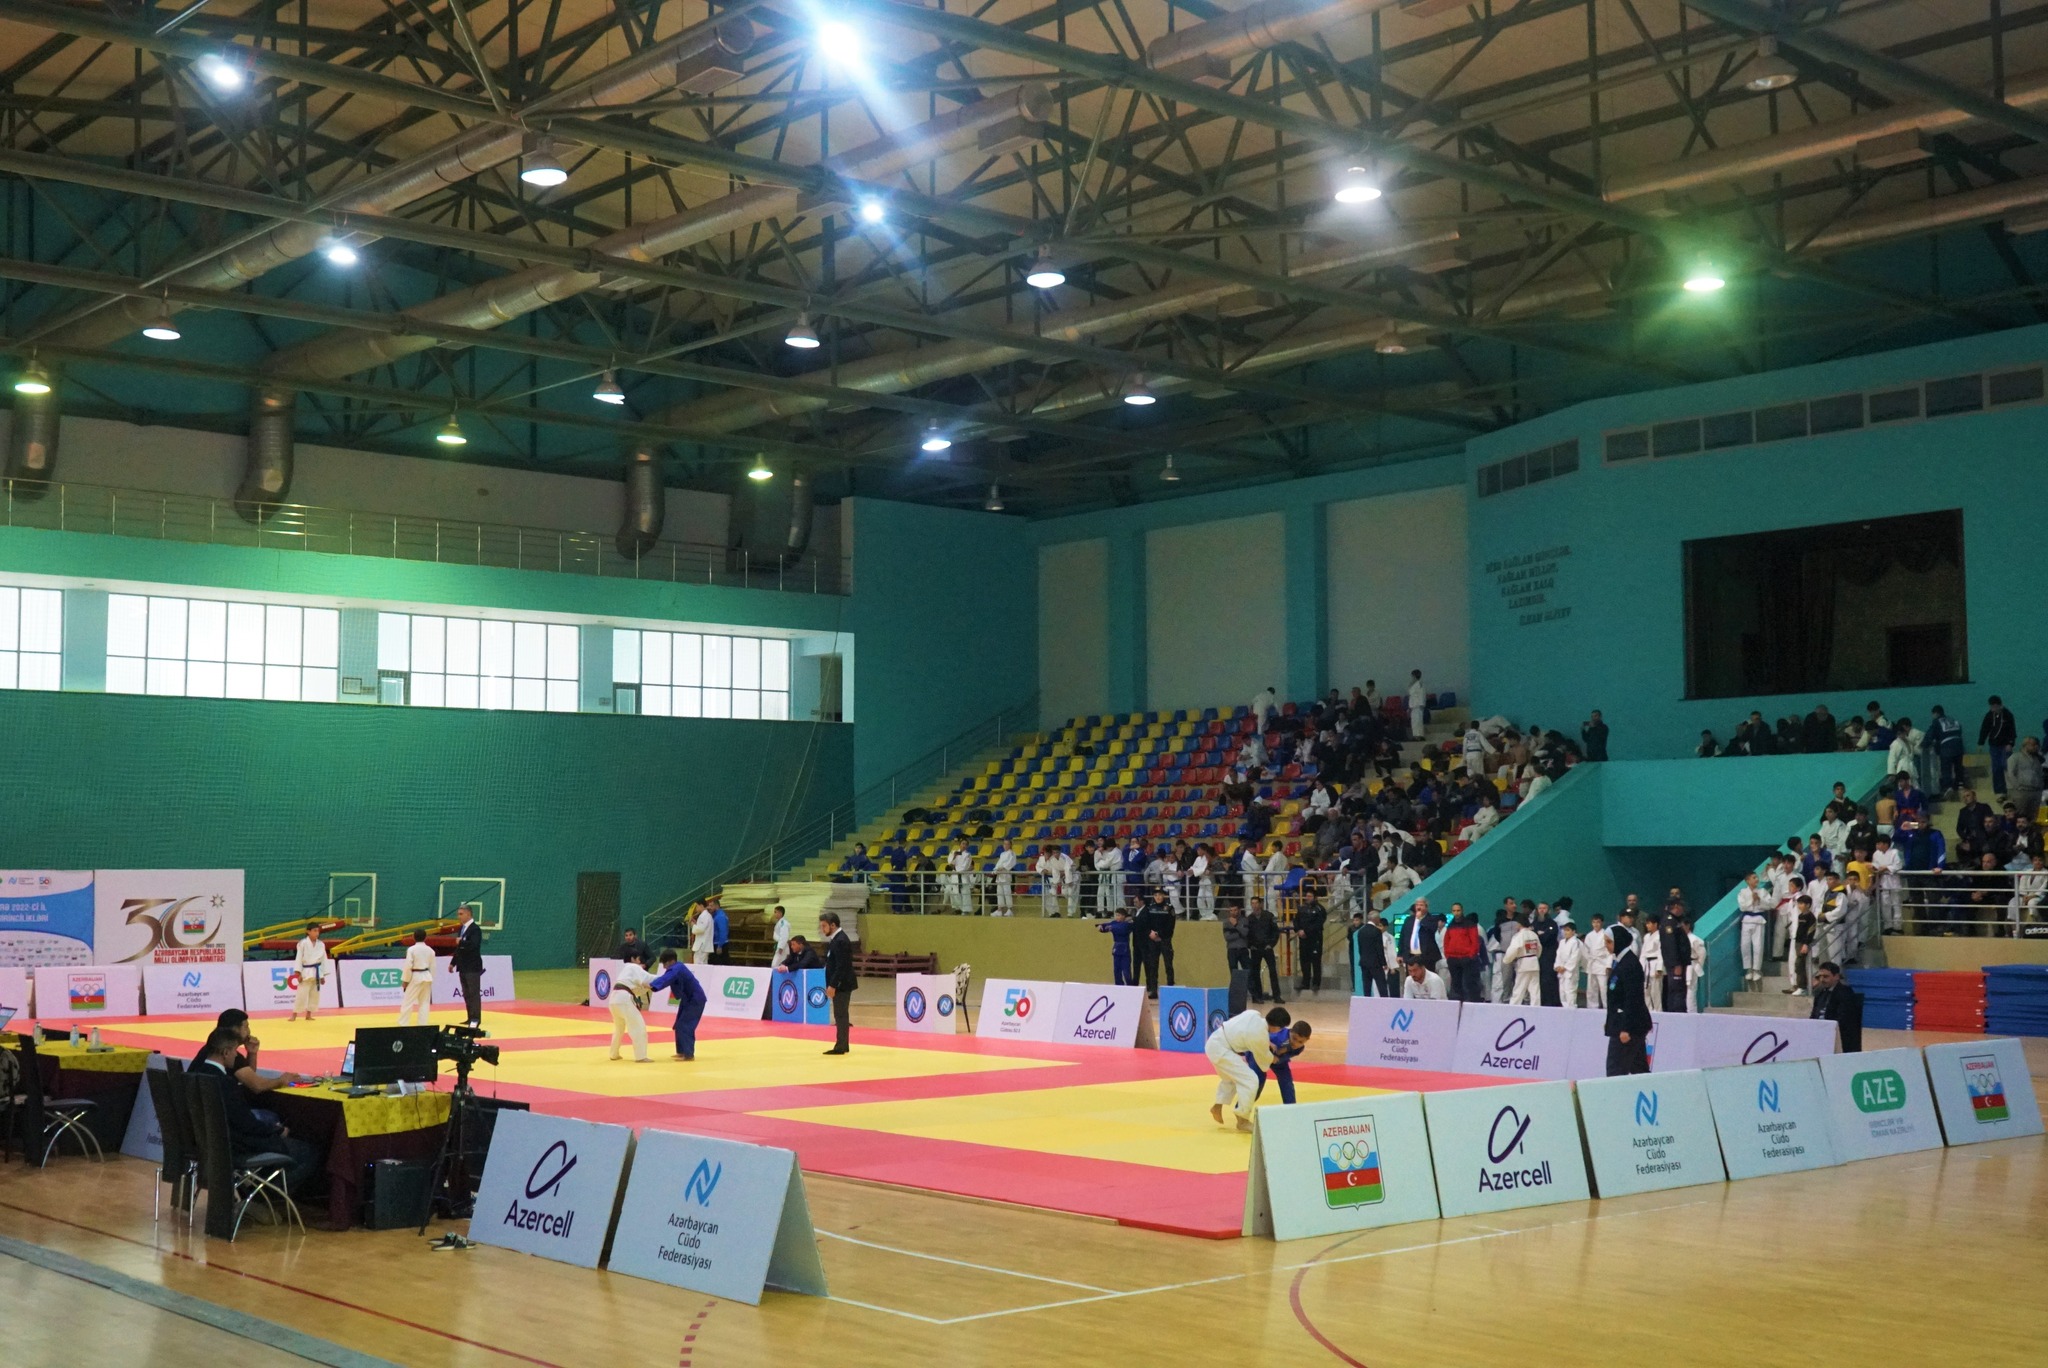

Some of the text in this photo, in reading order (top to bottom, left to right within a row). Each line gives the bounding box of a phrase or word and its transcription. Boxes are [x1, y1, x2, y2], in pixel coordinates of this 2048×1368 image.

[369, 971, 398, 985] AZE
[727, 980, 750, 995] AZE
[1074, 1024, 1117, 1040] Azercell
[1480, 1052, 1540, 1071] Azercell
[1863, 1077, 1898, 1105] AZE
[1322, 1123, 1371, 1138] AZERBAIJAN
[1646, 1149, 1666, 1160] Cüdo
[1478, 1160, 1552, 1192] Azercell
[504, 1200, 574, 1238] Azercell
[678, 1232, 701, 1249] Cüdo
